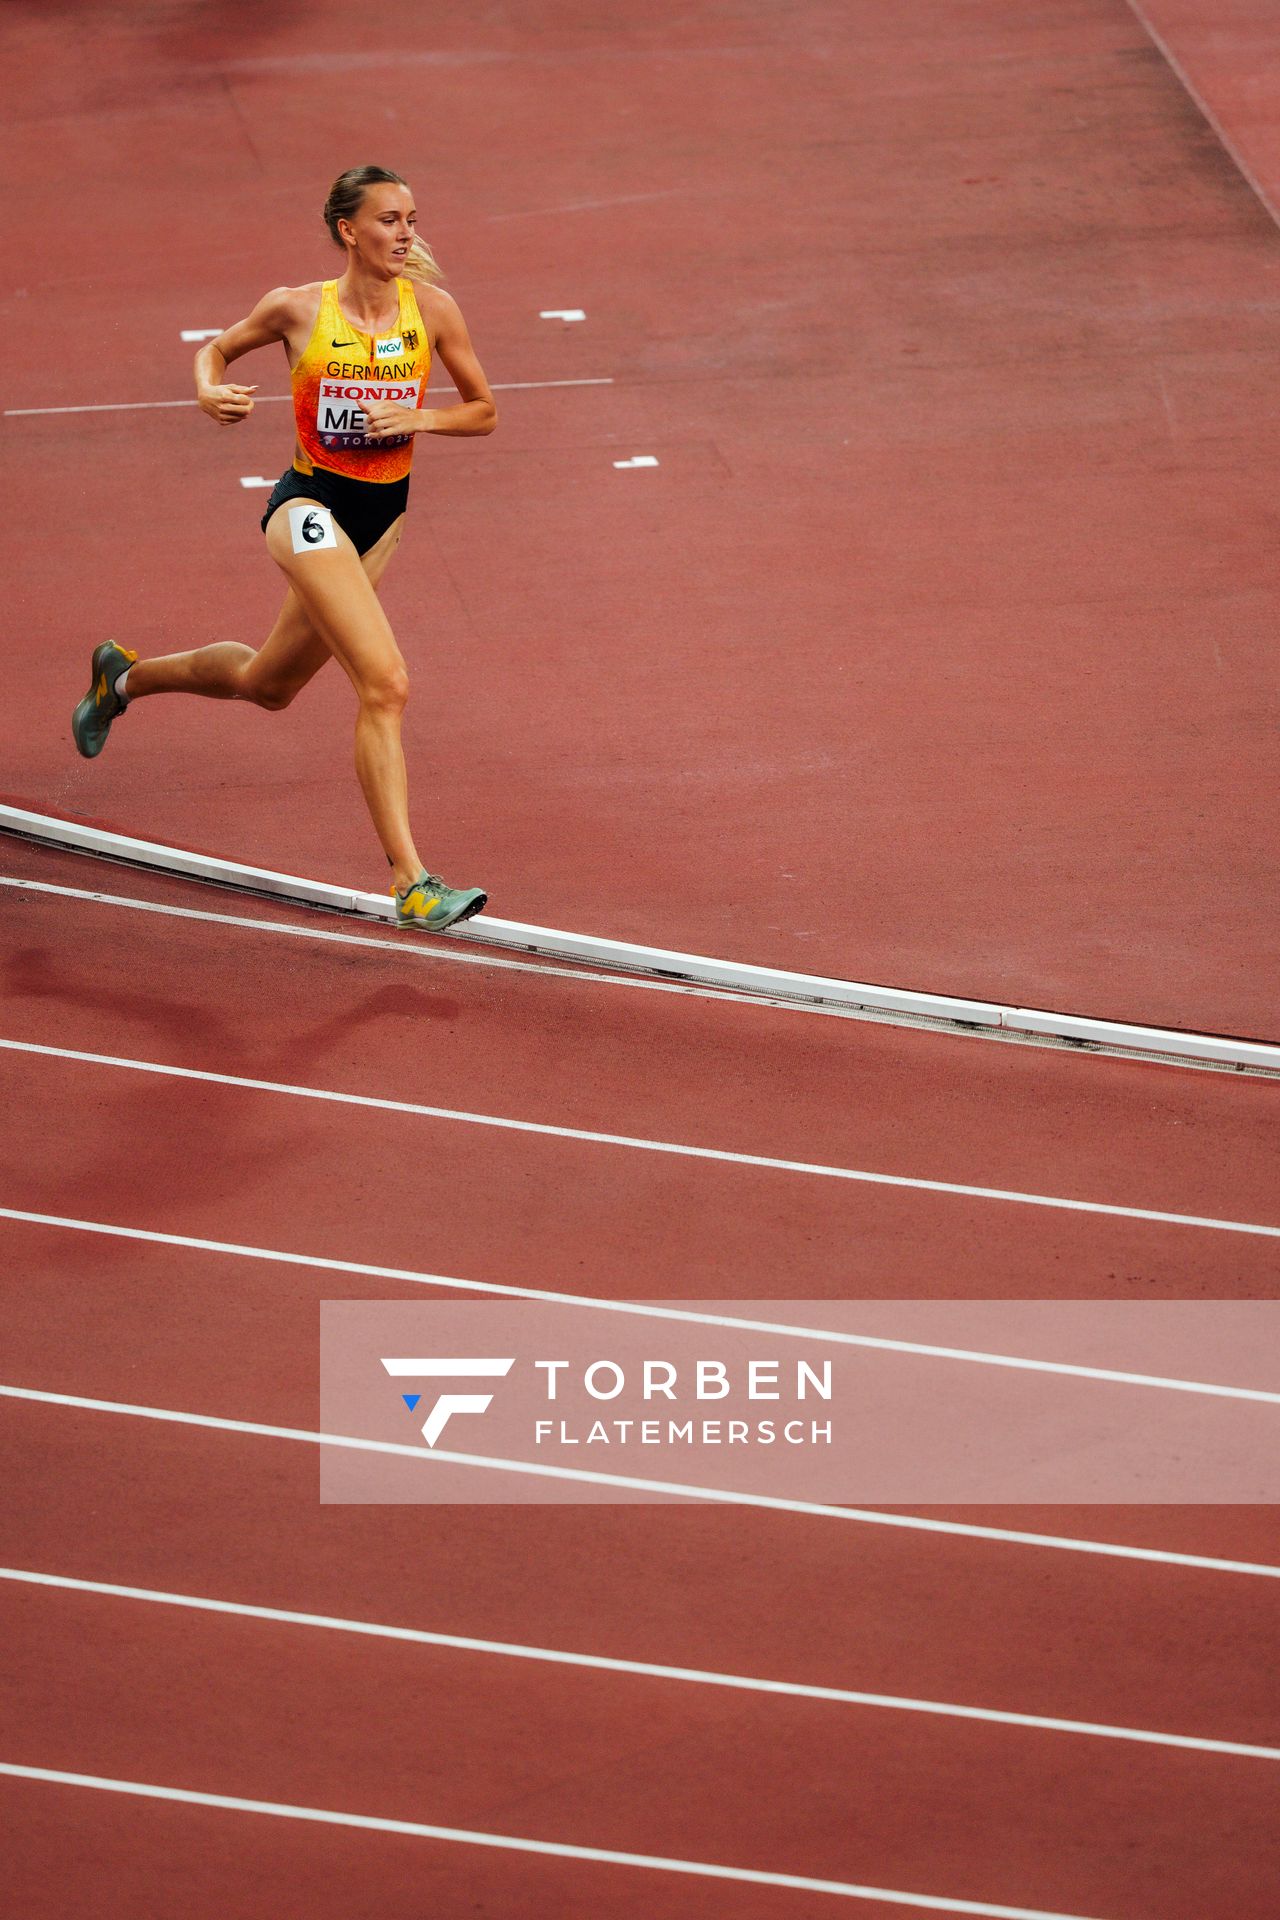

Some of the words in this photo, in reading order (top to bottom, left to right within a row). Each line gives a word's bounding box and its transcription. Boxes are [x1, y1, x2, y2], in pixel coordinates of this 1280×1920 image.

[377, 341, 402, 354] WGV
[326, 360, 416, 380] GERMANY
[321, 384, 417, 401] HONDA
[302, 511, 325, 544] 6
